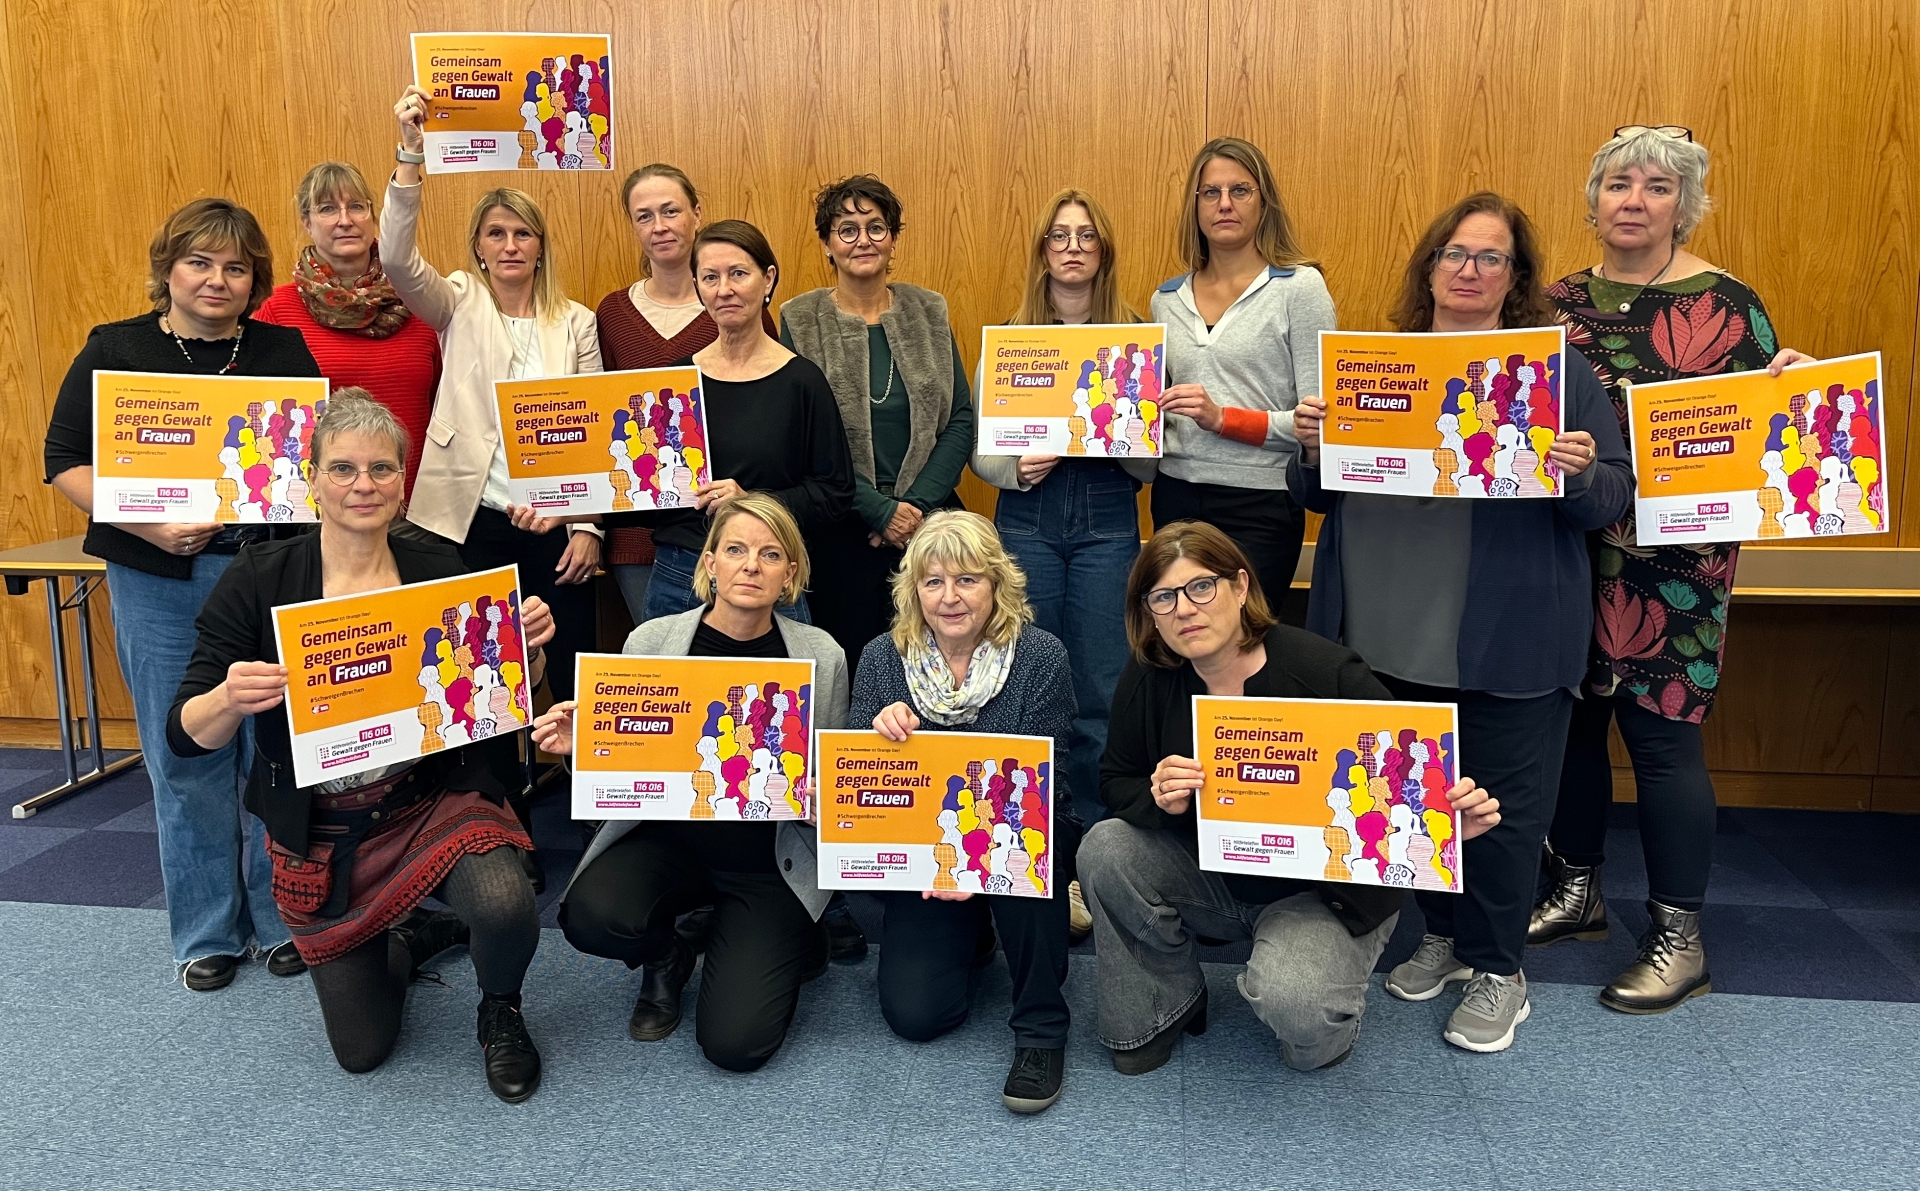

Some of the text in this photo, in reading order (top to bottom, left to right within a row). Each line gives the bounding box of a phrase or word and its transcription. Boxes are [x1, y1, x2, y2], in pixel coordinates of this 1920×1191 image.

[431, 56, 501, 67] Gemeinsam
[431, 70, 513, 83] gegen Gewalt
[433, 86, 496, 98] an Frauen
[997, 347, 1060, 357] Gemeinsam
[995, 360, 1069, 372] gegen Gewalt
[1336, 359, 1415, 374] Gemeinsam
[995, 375, 1052, 385] an Frauen
[1336, 377, 1429, 391] gegen Gewalt
[115, 396, 199, 411] Gemeinsam
[514, 400, 586, 414] Gemeinsam
[1337, 395, 1407, 409] an Frauen
[114, 414, 212, 426] gegen Gewalt
[1650, 404, 1737, 423] Gemeinsam
[516, 412, 599, 431] gegen Gewalt
[115, 429, 191, 443] an Frauen
[1650, 417, 1752, 442] gegen Gewalt
[518, 431, 582, 444] an Frauen
[1652, 441, 1730, 458] an Frauen
[1390, 459, 1404, 467] 016
[1700, 504, 1727, 513] 116 016
[302, 621, 392, 648] Gemeinsam
[304, 634, 407, 669] gegen Gewalt
[307, 660, 387, 687] an Frauen
[595, 682, 679, 696] Gemeinsam
[593, 700, 691, 714] gegen Gewalt
[594, 718, 669, 732] an Frauen
[362, 726, 389, 740] 116 016
[1215, 726, 1303, 742] Gemeinsam
[332, 737, 392, 756] Gewalt gegen Frauen
[1214, 746, 1318, 761] gegen Gewalt
[836, 757, 918, 770] Gemeinsam
[1216, 765, 1295, 781] an Frauen
[636, 783, 662, 791] 116 016
[835, 774, 931, 788] gegen Gewalt
[836, 792, 910, 805] an Frauen
[1264, 836, 1292, 846] 116 016
